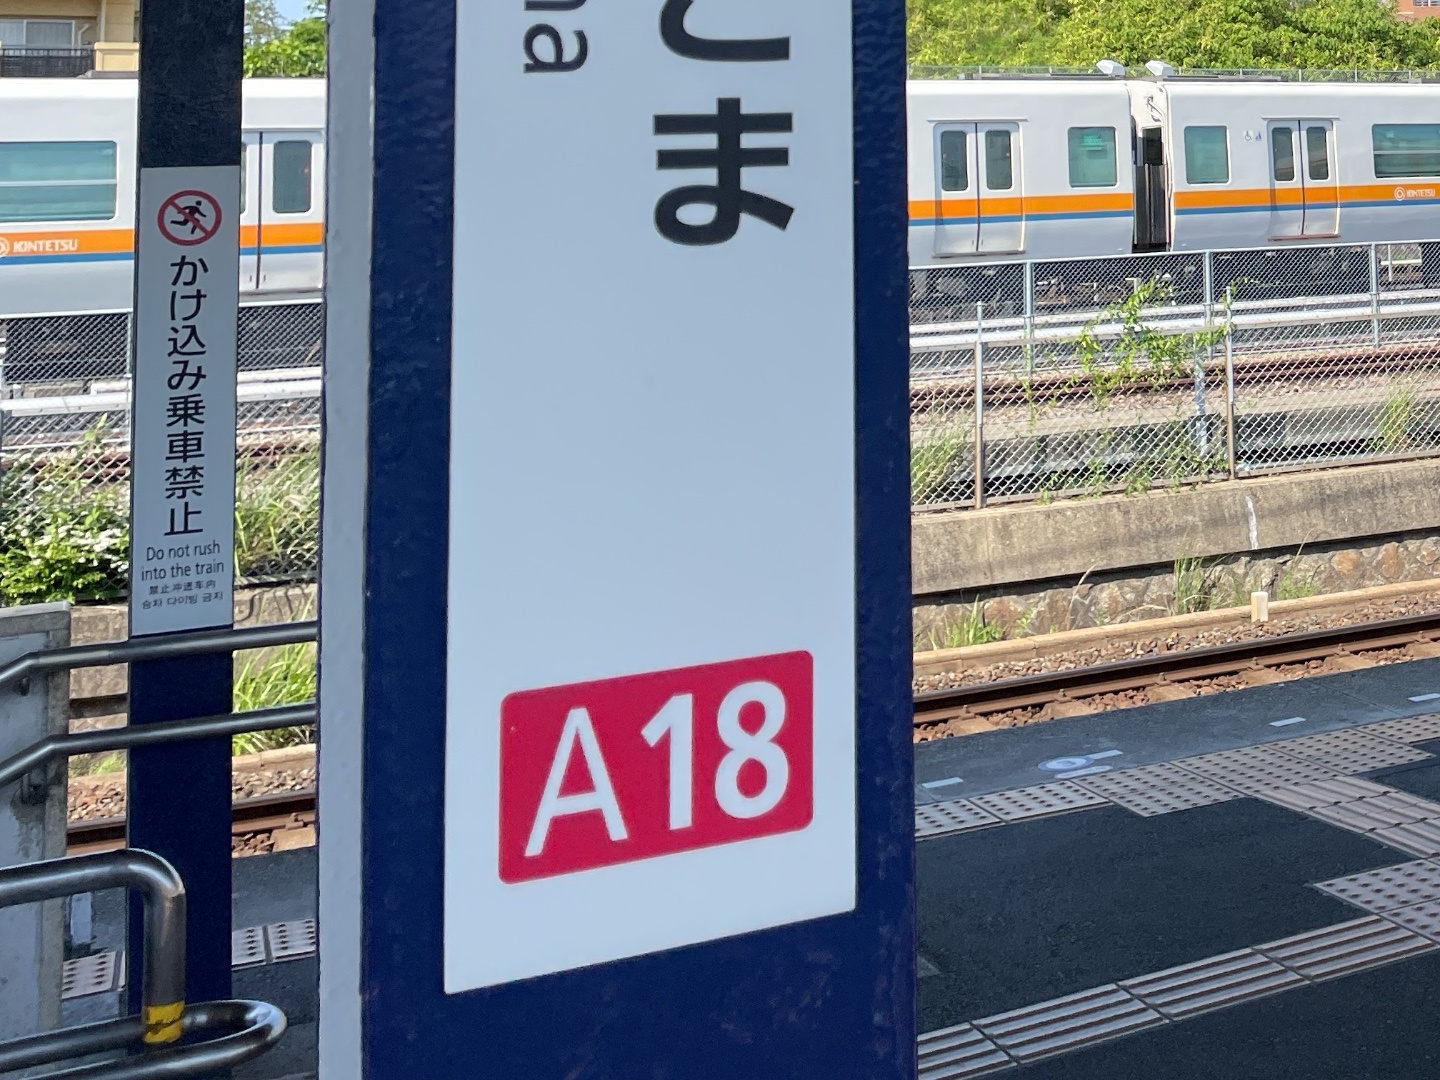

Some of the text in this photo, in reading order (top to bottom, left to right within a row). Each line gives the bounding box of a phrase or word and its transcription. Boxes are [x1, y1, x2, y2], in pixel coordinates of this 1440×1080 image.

[13, 239, 78, 253] KINTETSU
[164, 255, 209, 536] かけ込み乗車禁止
[146, 539, 220, 561] Do not rush
[141, 558, 224, 581] into the train
[524, 680, 790, 858] A18
